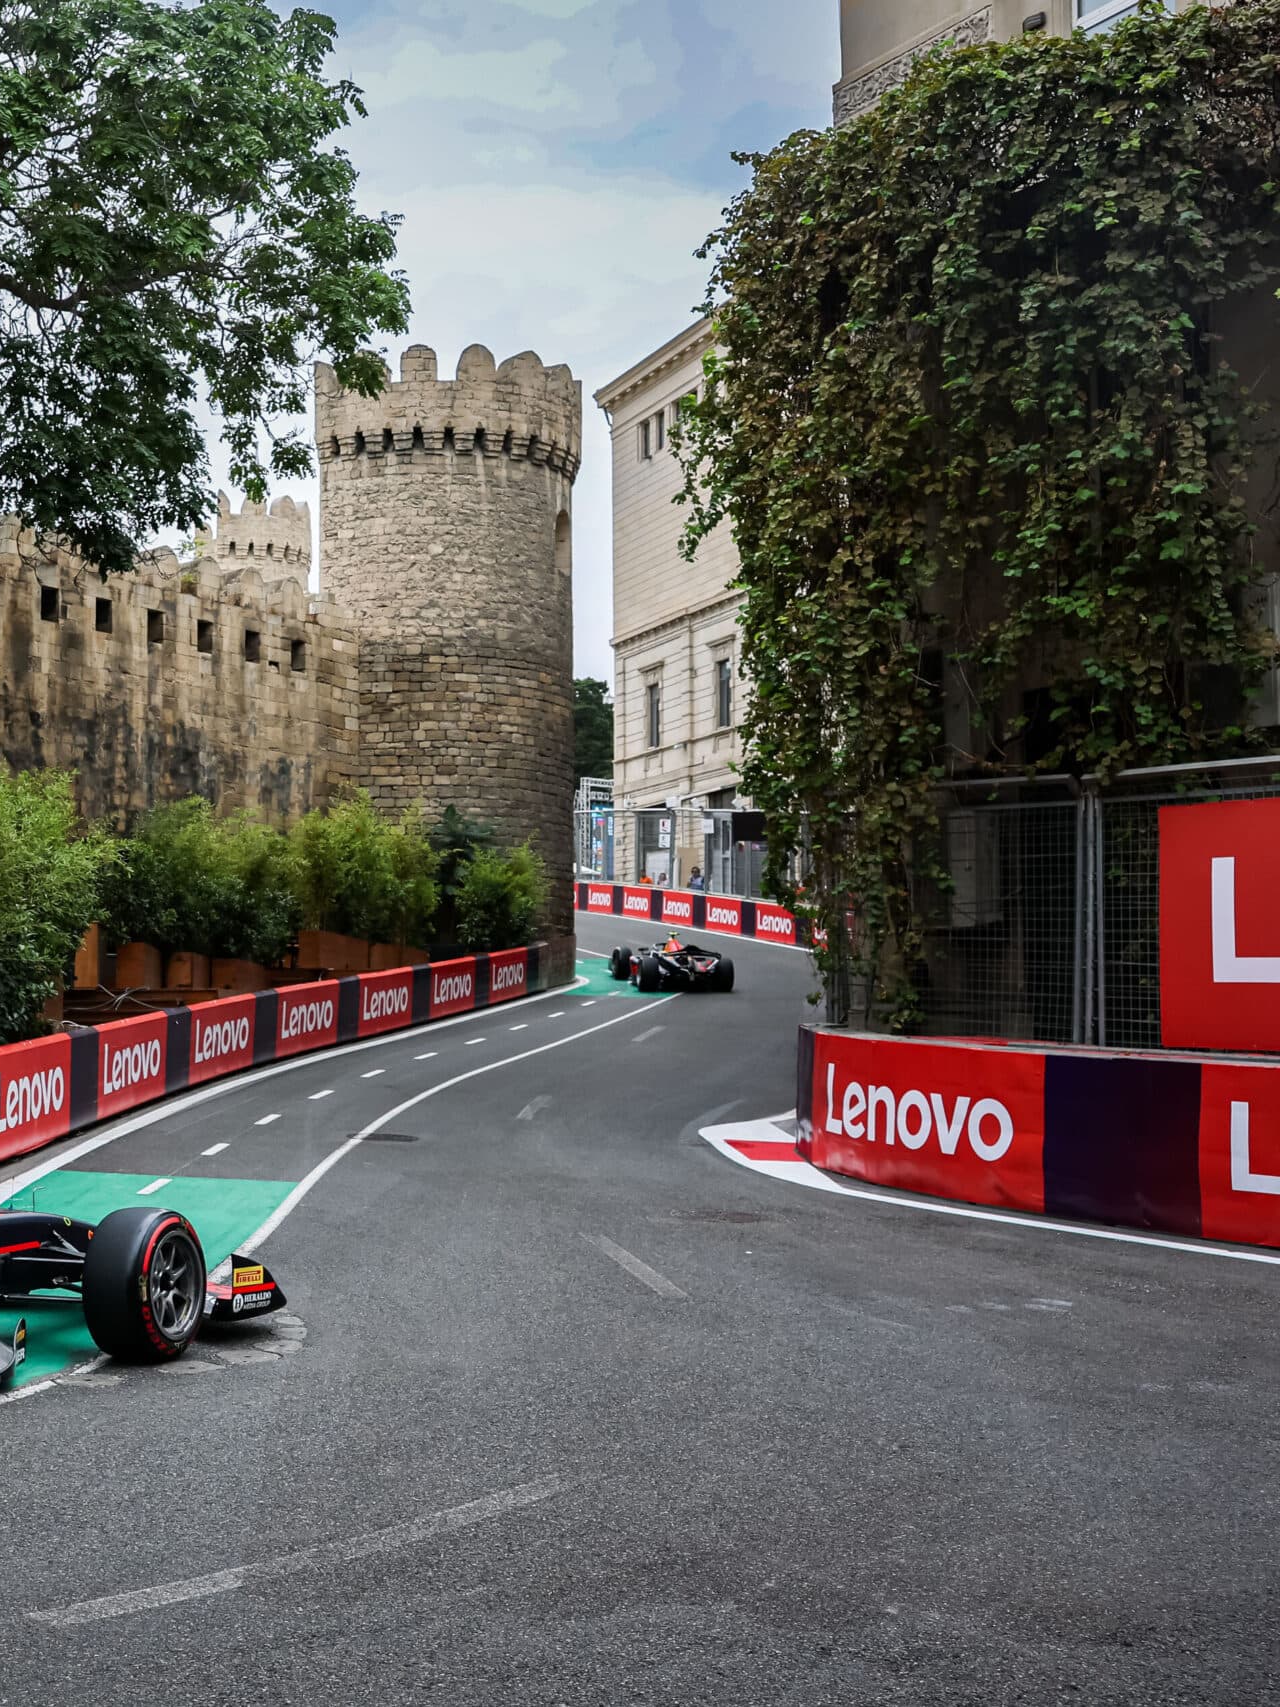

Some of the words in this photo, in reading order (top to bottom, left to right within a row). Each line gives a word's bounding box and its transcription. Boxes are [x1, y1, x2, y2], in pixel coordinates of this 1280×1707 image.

[588, 887, 611, 907] Lenovo
[624, 892, 648, 912] Lenovo
[662, 899, 690, 918] Lenovo
[707, 905, 738, 926] Lenovo
[757, 909, 792, 935] Lenovo
[433, 972, 472, 1005] Lenovo
[492, 962, 524, 991] Lenovo
[363, 985, 409, 1021] Lenovo
[281, 999, 333, 1040] Lenovo
[194, 1016, 249, 1064] Lenovo
[104, 1038, 161, 1095] Lenovo
[826, 1062, 1014, 1162] Lenovo
[235, 1269, 261, 1284] PIRELLI
[244, 1290, 272, 1303] HERALDO
